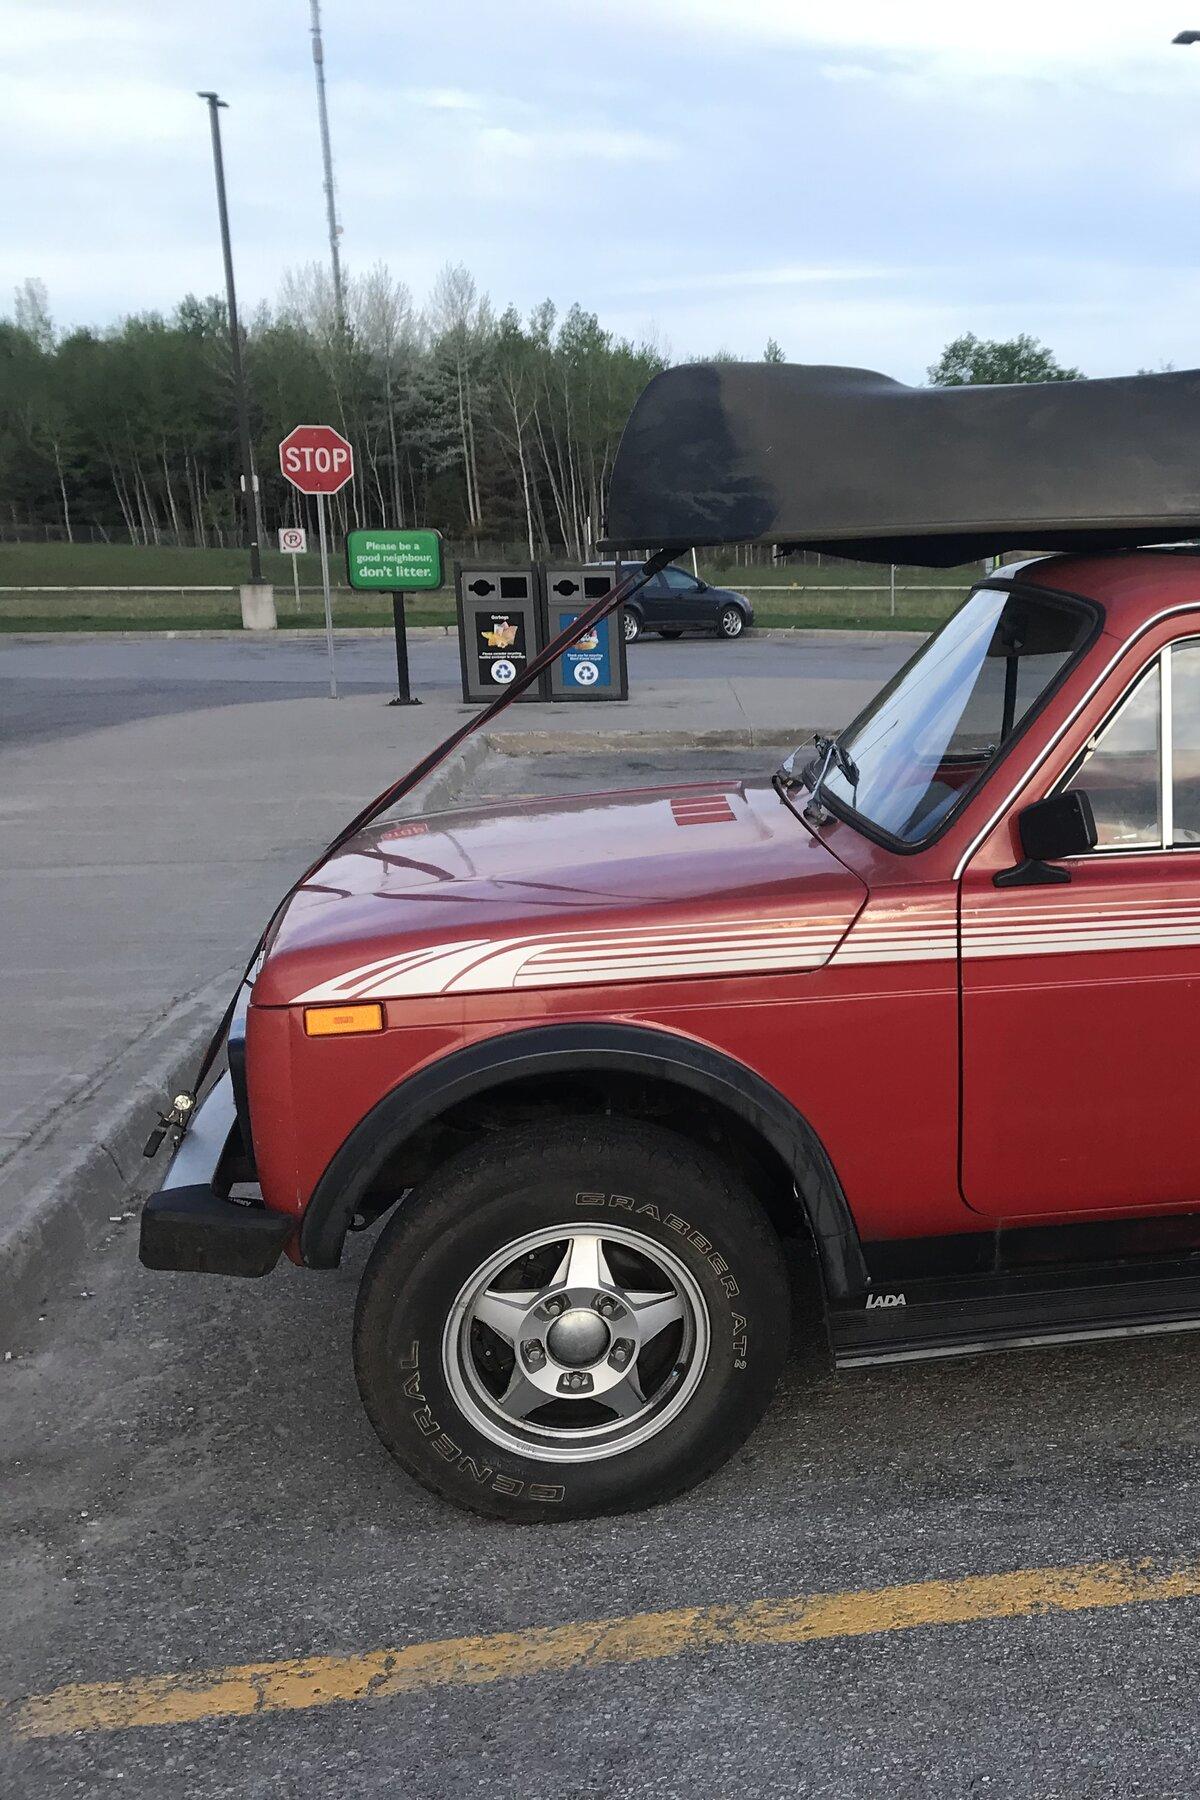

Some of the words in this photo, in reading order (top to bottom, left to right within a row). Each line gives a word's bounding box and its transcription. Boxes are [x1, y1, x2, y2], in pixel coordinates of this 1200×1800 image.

[285, 446, 348, 473] STOP
[365, 541, 397, 551] Please
[398, 541, 412, 551] be
[413, 543, 420, 551] a
[356, 553, 381, 564] good
[382, 553, 433, 564] neighbour,
[359, 566, 393, 578] don't
[395, 565, 432, 578] litter.
[574, 1191, 741, 1300] GRABBER
[865, 1293, 907, 1309] LADA
[400, 1340, 566, 1502] GENERAL
